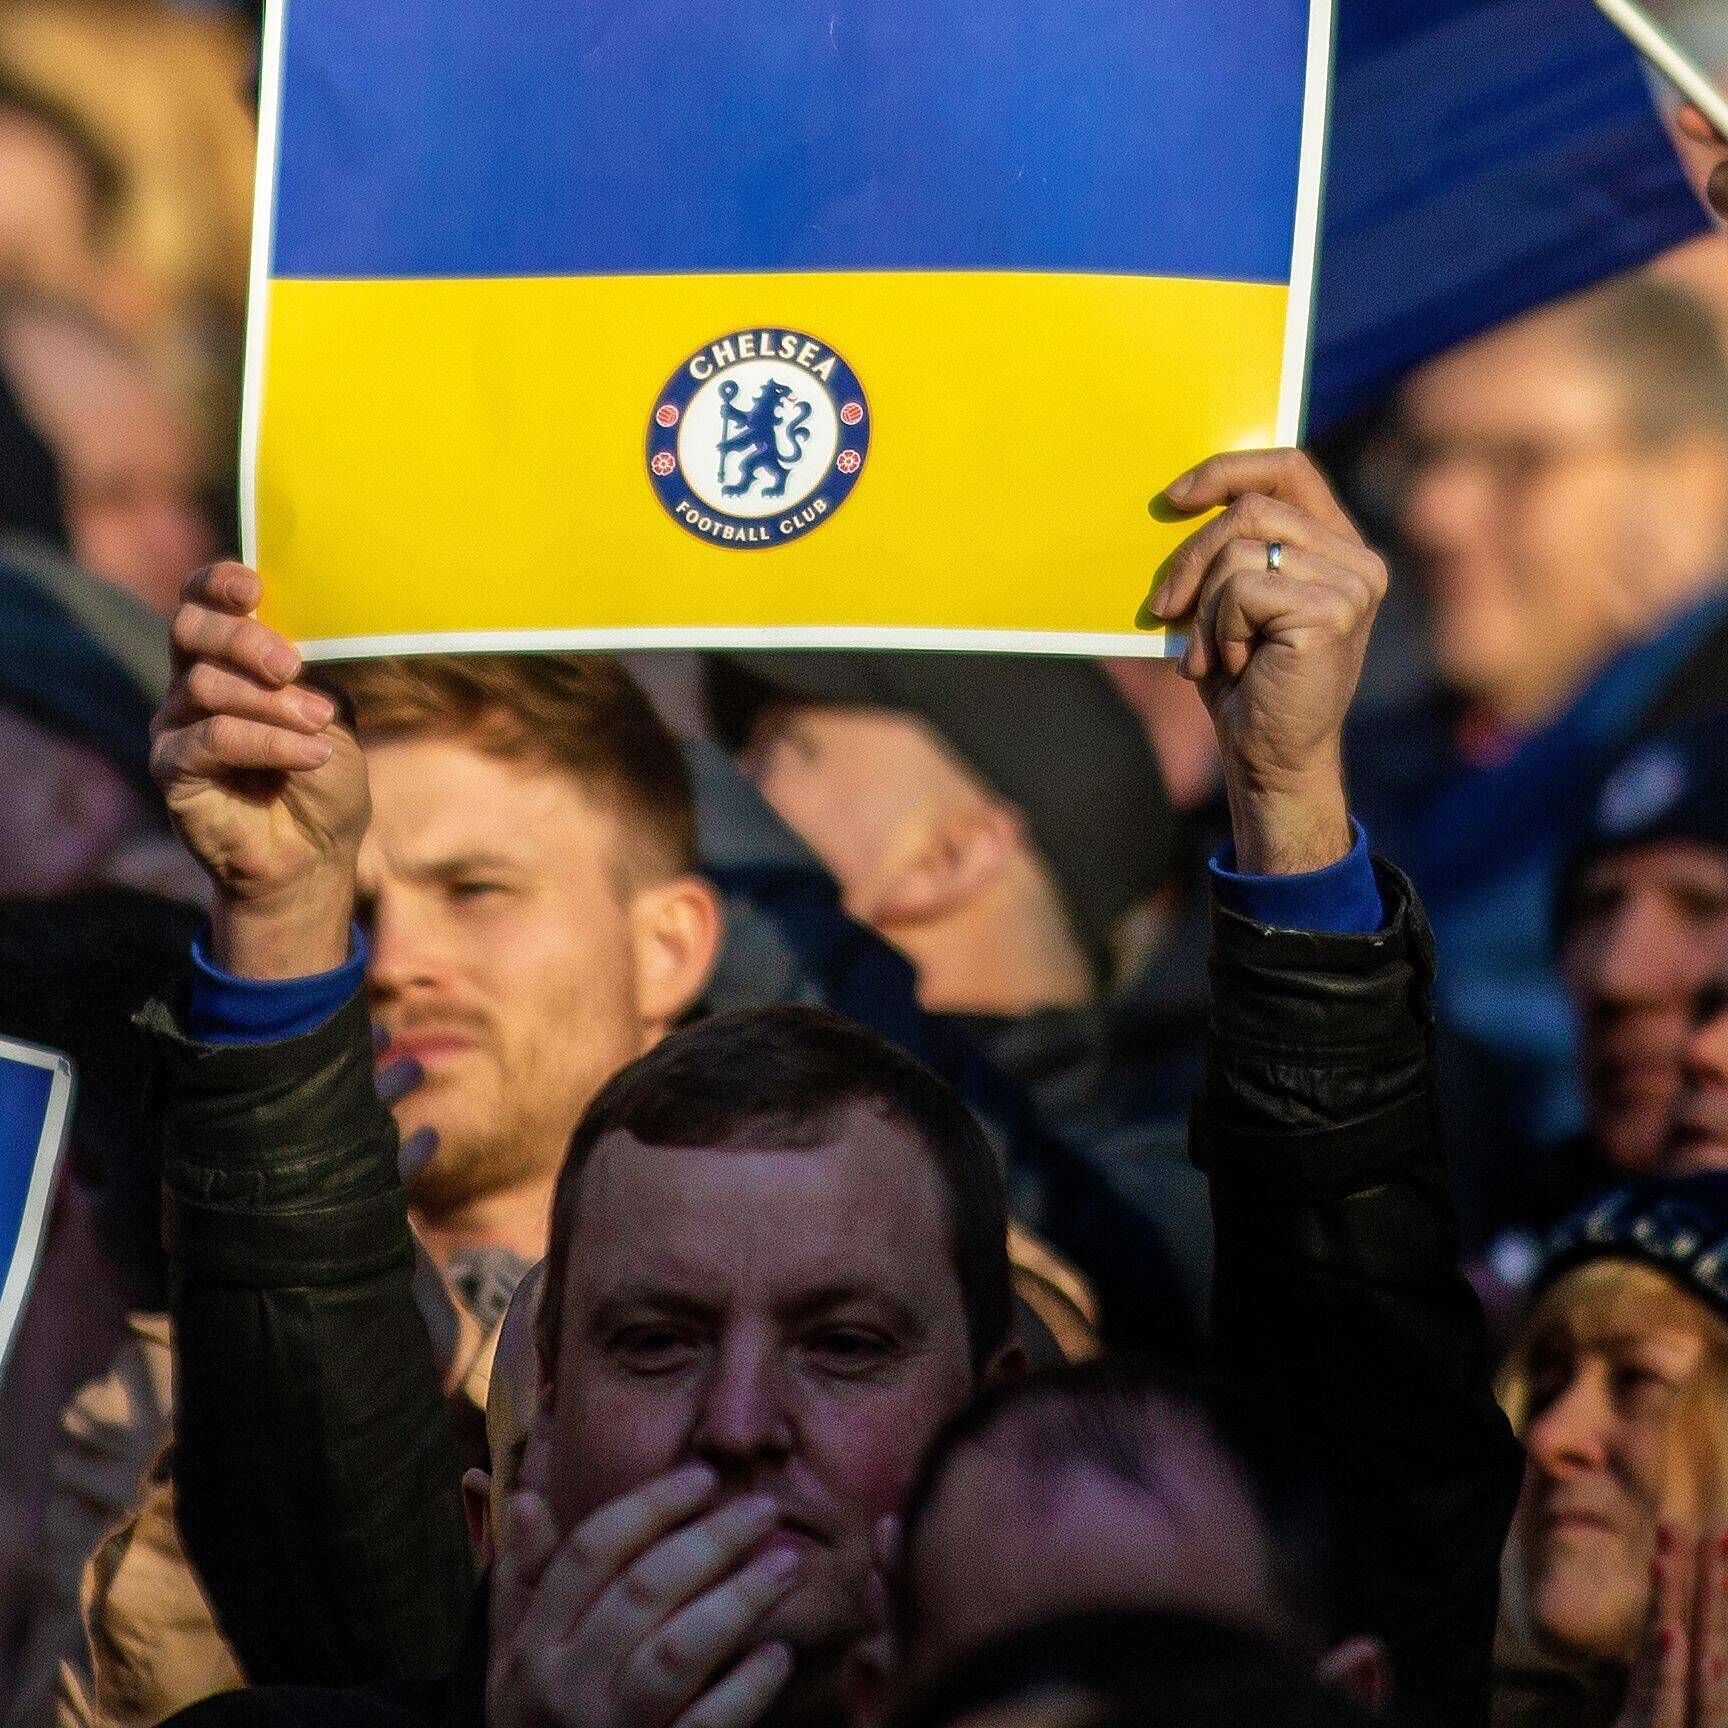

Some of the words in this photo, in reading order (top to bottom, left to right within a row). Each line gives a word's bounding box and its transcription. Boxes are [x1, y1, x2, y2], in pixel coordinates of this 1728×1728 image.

[688, 332, 838, 382] CHELSEA
[675, 500, 771, 542] FOOTBALL
[778, 498, 829, 535] CLUB
